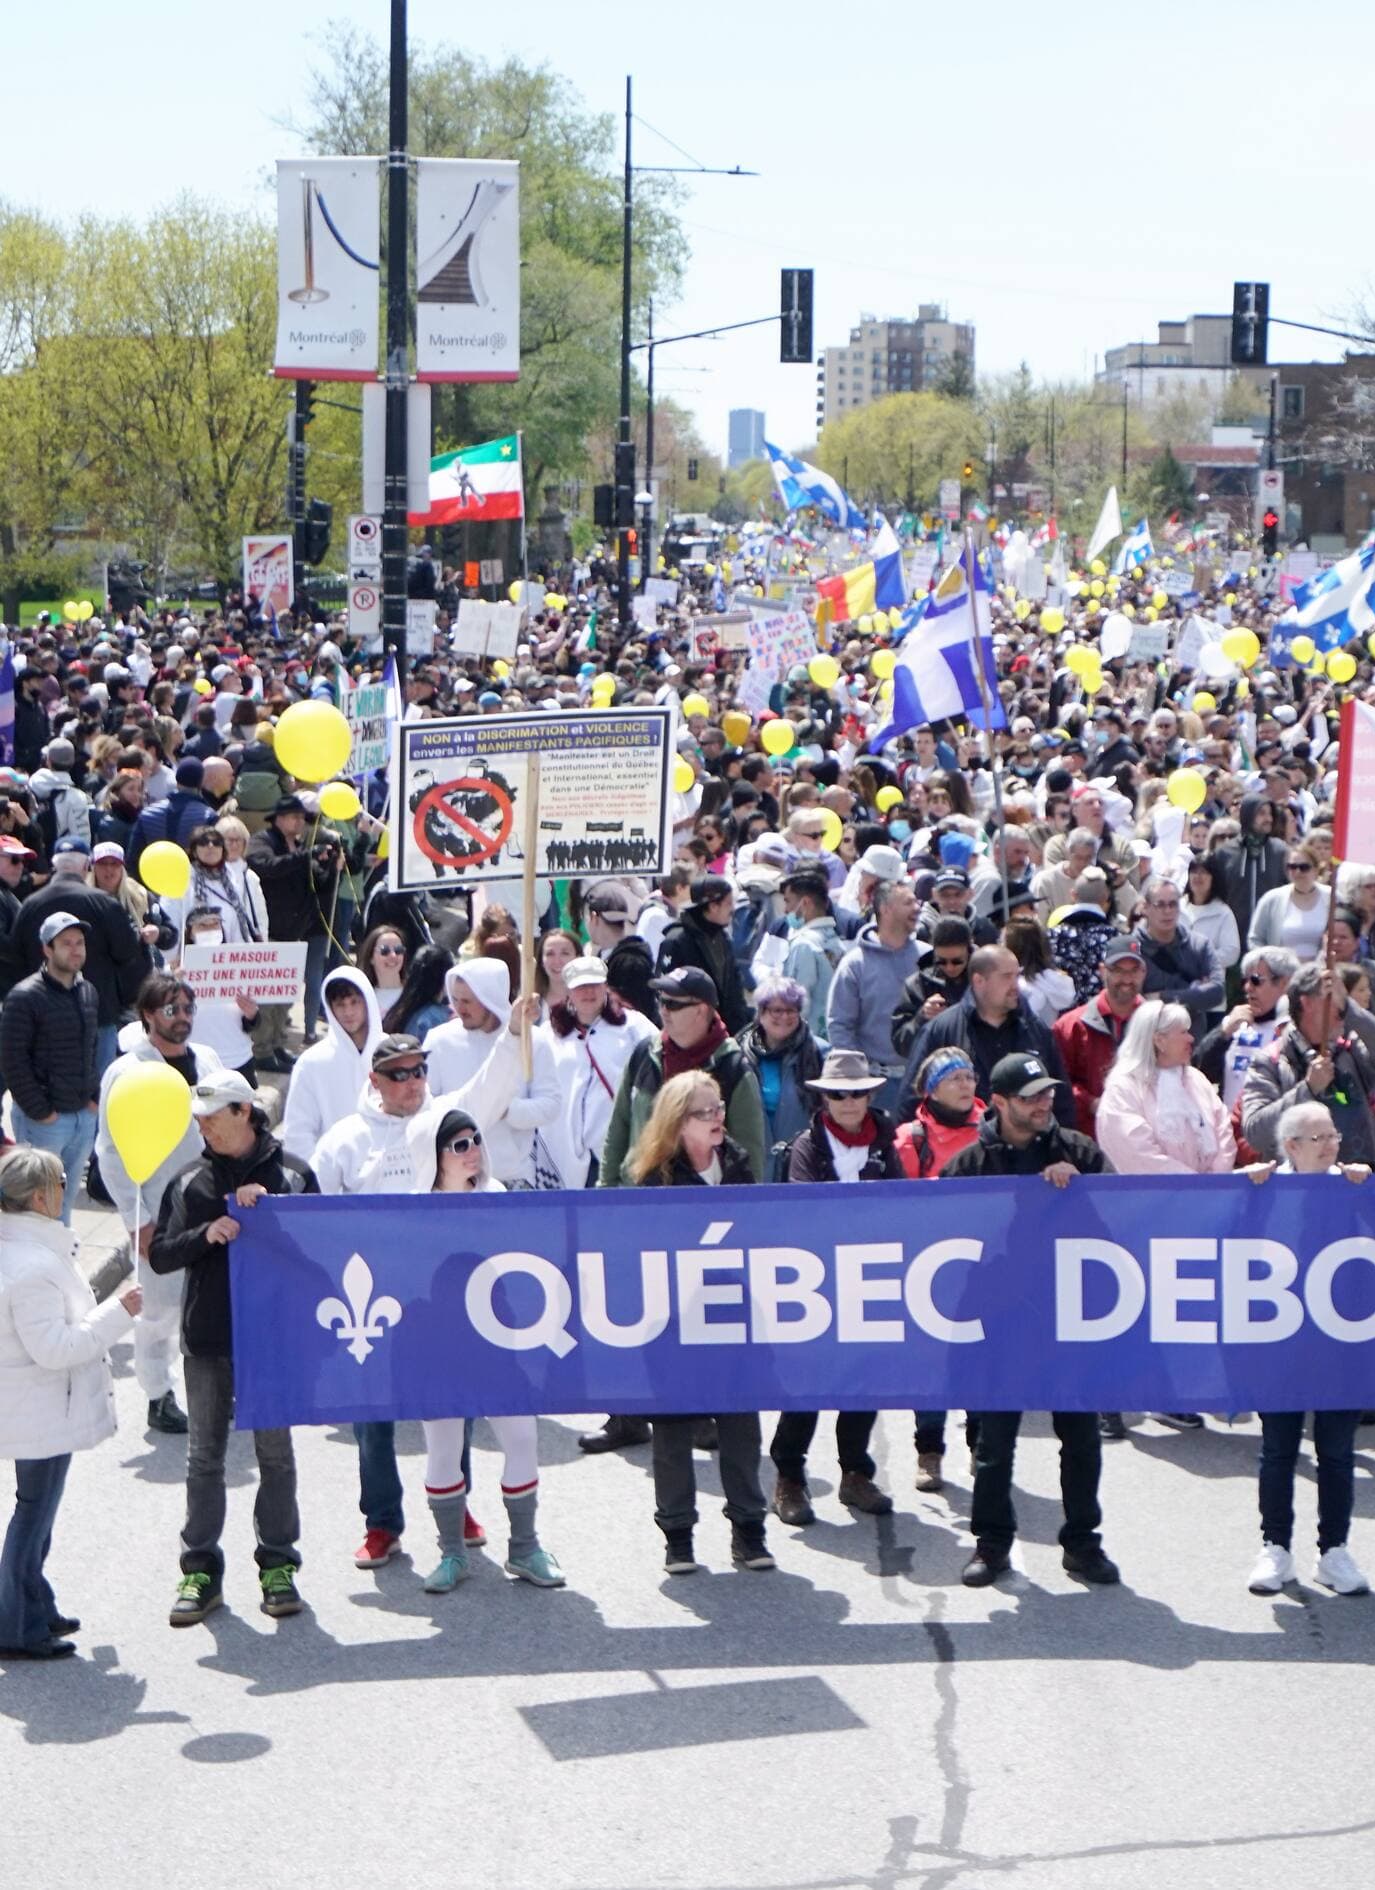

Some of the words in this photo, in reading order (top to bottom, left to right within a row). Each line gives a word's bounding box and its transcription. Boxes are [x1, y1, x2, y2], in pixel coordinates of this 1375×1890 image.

[289, 330, 348, 344] Montréal
[429, 333, 489, 347] Montréal
[423, 734, 451, 745] NON
[453, 731, 461, 742] à
[464, 732, 475, 742] la
[571, 725, 583, 735] et
[586, 722, 649, 734] VIOLENCE
[413, 746, 454, 758] envers
[457, 745, 473, 755] les
[476, 738, 572, 753] MANIFESTANTS
[576, 735, 650, 746] PACIFIQUES
[212, 952, 225, 963] LE
[229, 951, 278, 964] MASQUE
[213, 968, 235, 981] UNE
[240, 967, 298, 980] NUISANCE
[193, 987, 216, 998] OUR
[220, 986, 246, 998] NOS
[247, 984, 297, 998] ENFANTS
[464, 1221, 986, 1359] QUÉBEC
